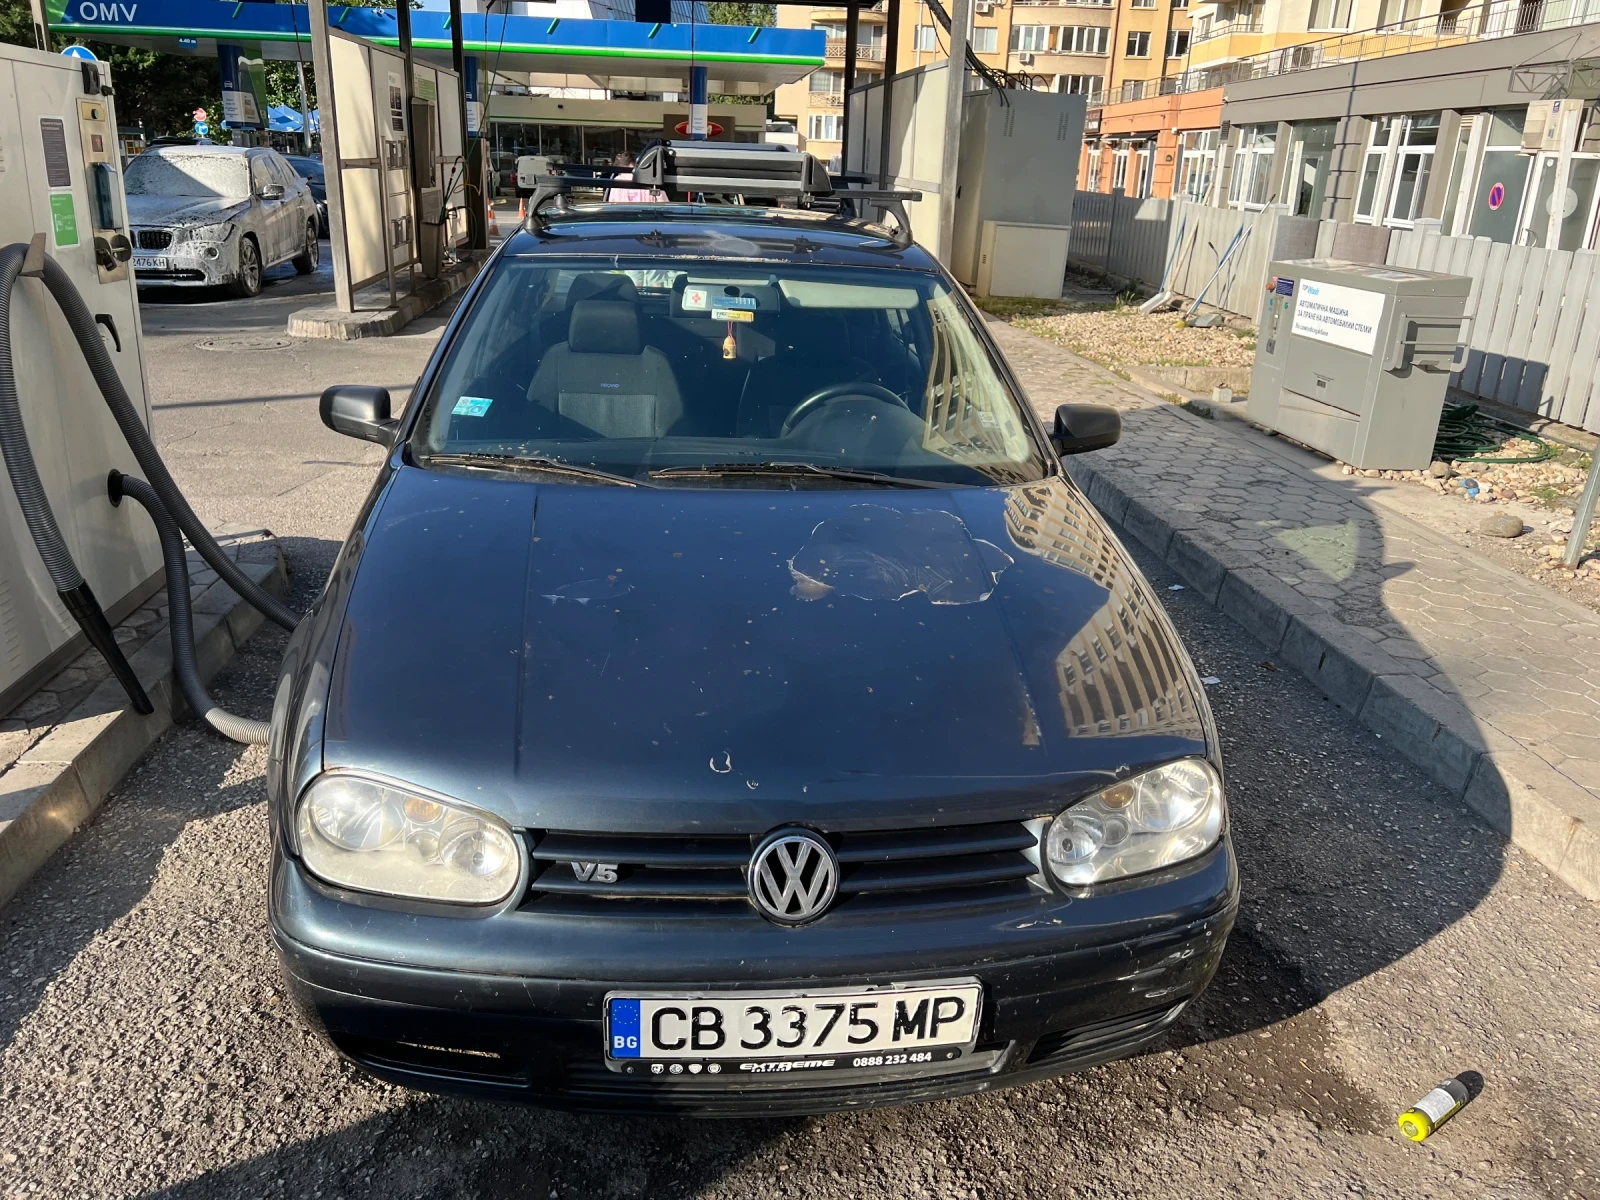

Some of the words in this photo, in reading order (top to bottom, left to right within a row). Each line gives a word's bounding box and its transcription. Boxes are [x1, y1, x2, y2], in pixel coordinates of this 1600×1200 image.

[79, 1, 138, 22] OMV
[1299, 299, 1328, 313] АВТОМАТИЧНА
[1329, 306, 1349, 317] МАШИНА
[1297, 309, 1303, 317] ЗА
[1302, 310, 1316, 321] ПРАНЕ
[1316, 314, 1322, 322] НА
[1322, 315, 1355, 330] АВТОМОБИЛНИ
[1354, 323, 1372, 334] СТЕЛКИ
[570, 861, 618, 884] V5
[651, 1006, 726, 1051] CB
[740, 1001, 879, 1050] 3375
[891, 995, 966, 1042] MP
[613, 1036, 638, 1049] BG
[739, 1059, 836, 1072] EXTREME
[852, 1056, 884, 1067] 0888
[884, 1054, 908, 1065] 232
[909, 1051, 933, 1063] 484
